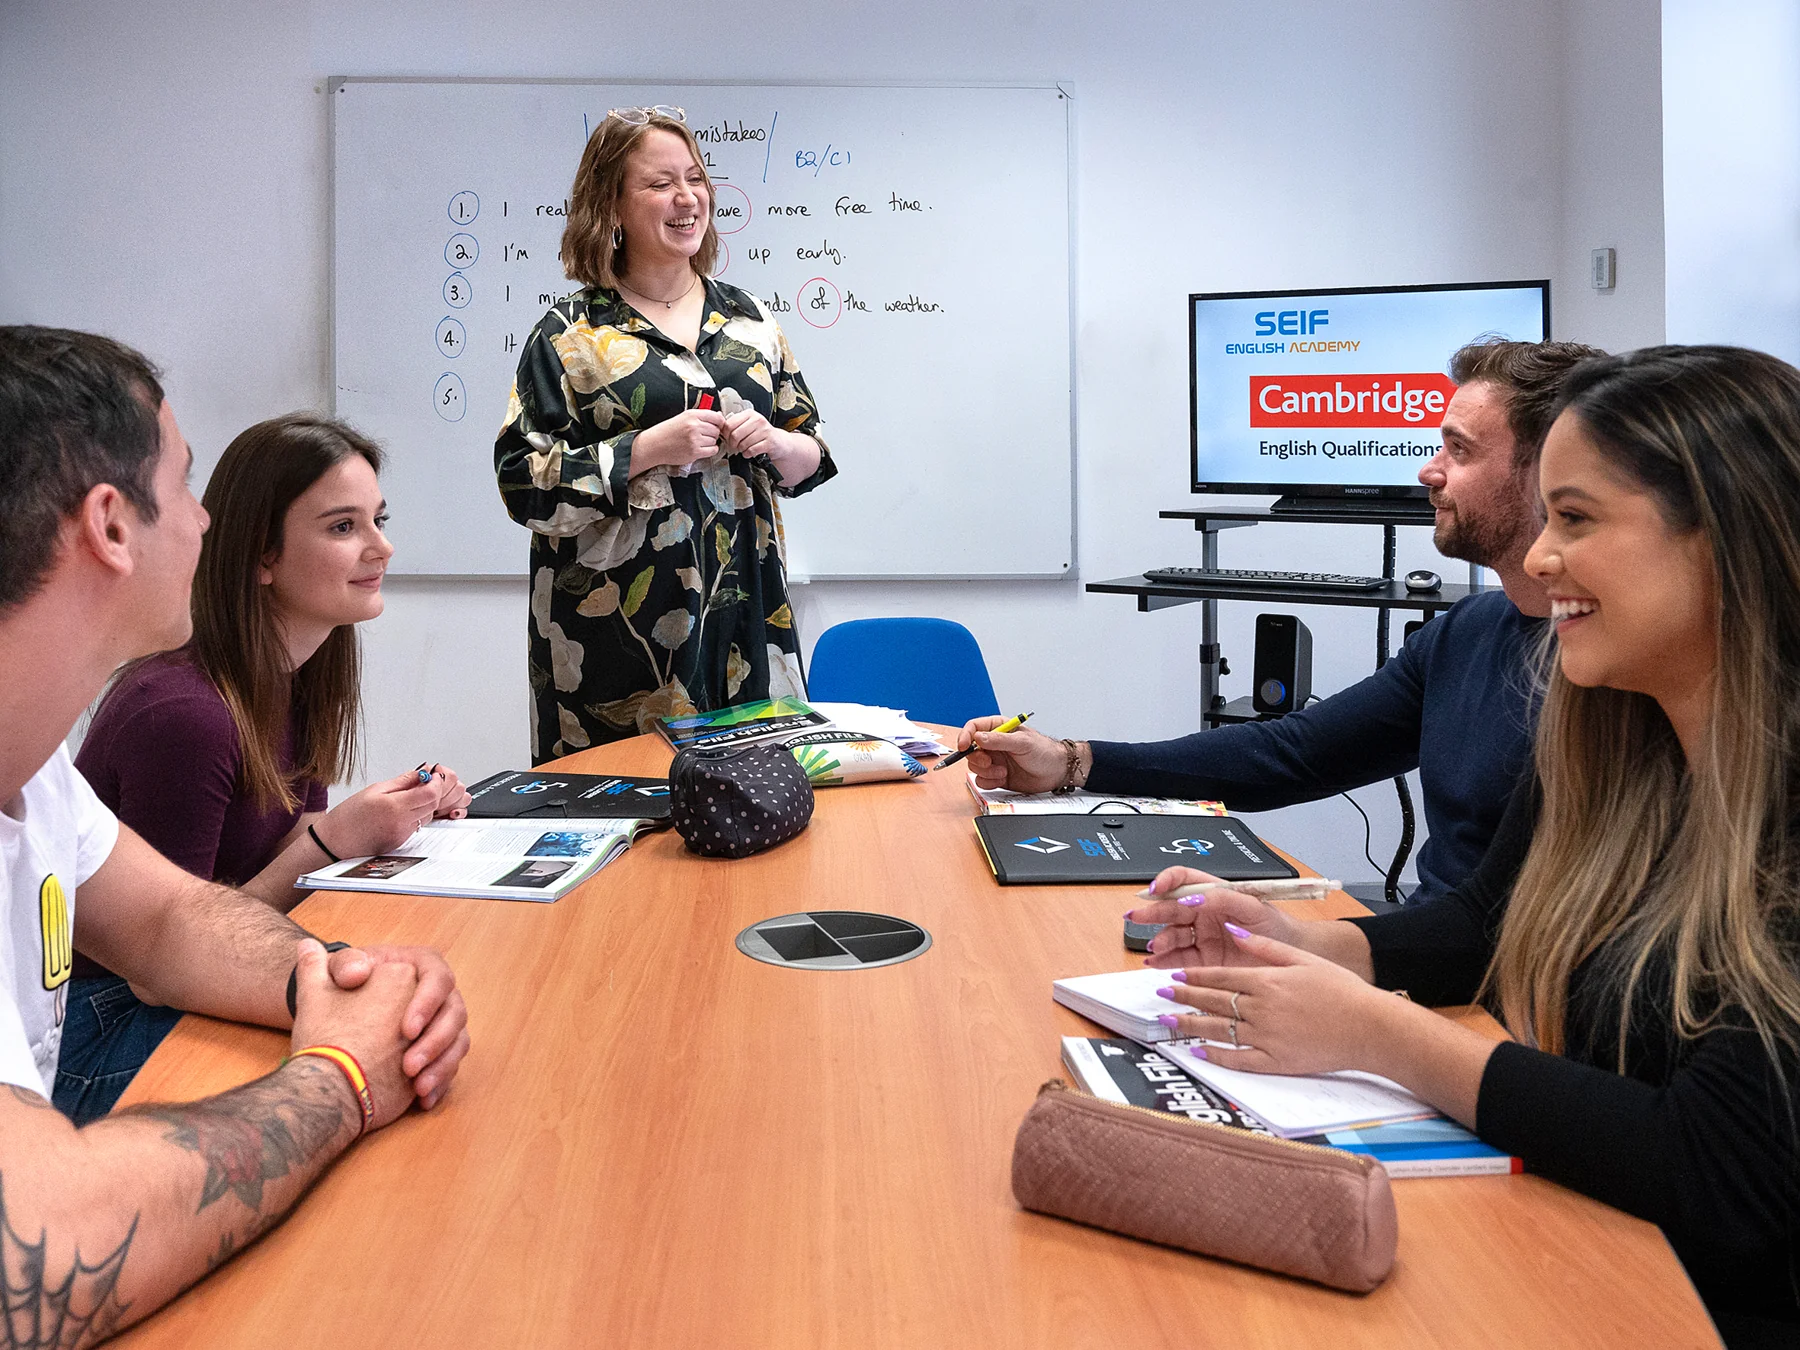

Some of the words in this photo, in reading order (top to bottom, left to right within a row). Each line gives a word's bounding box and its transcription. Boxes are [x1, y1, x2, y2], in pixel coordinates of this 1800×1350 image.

[459, 201, 470, 219] 1.
[536, 198, 569, 217] real
[716, 204, 742, 217] ave
[768, 203, 811, 217] more
[889, 192, 932, 212] time.
[455, 244, 473, 259] 2.
[748, 249, 771, 264] up
[796, 240, 846, 266] early.
[450, 285, 464, 301] 3.
[762, 292, 791, 313] nds
[810, 286, 831, 310] of
[845, 290, 872, 313] the
[884, 293, 945, 314] weather.
[1256, 310, 1328, 336] SEIF
[444, 330, 459, 346] 4.
[1225, 342, 1285, 355] ENGLISH
[1290, 340, 1361, 353] ACADEMY
[443, 388, 458, 405] 5.
[1258, 382, 1445, 422] Cambridge
[1259, 440, 1317, 460] English
[1135, 1053, 1187, 1082] File
